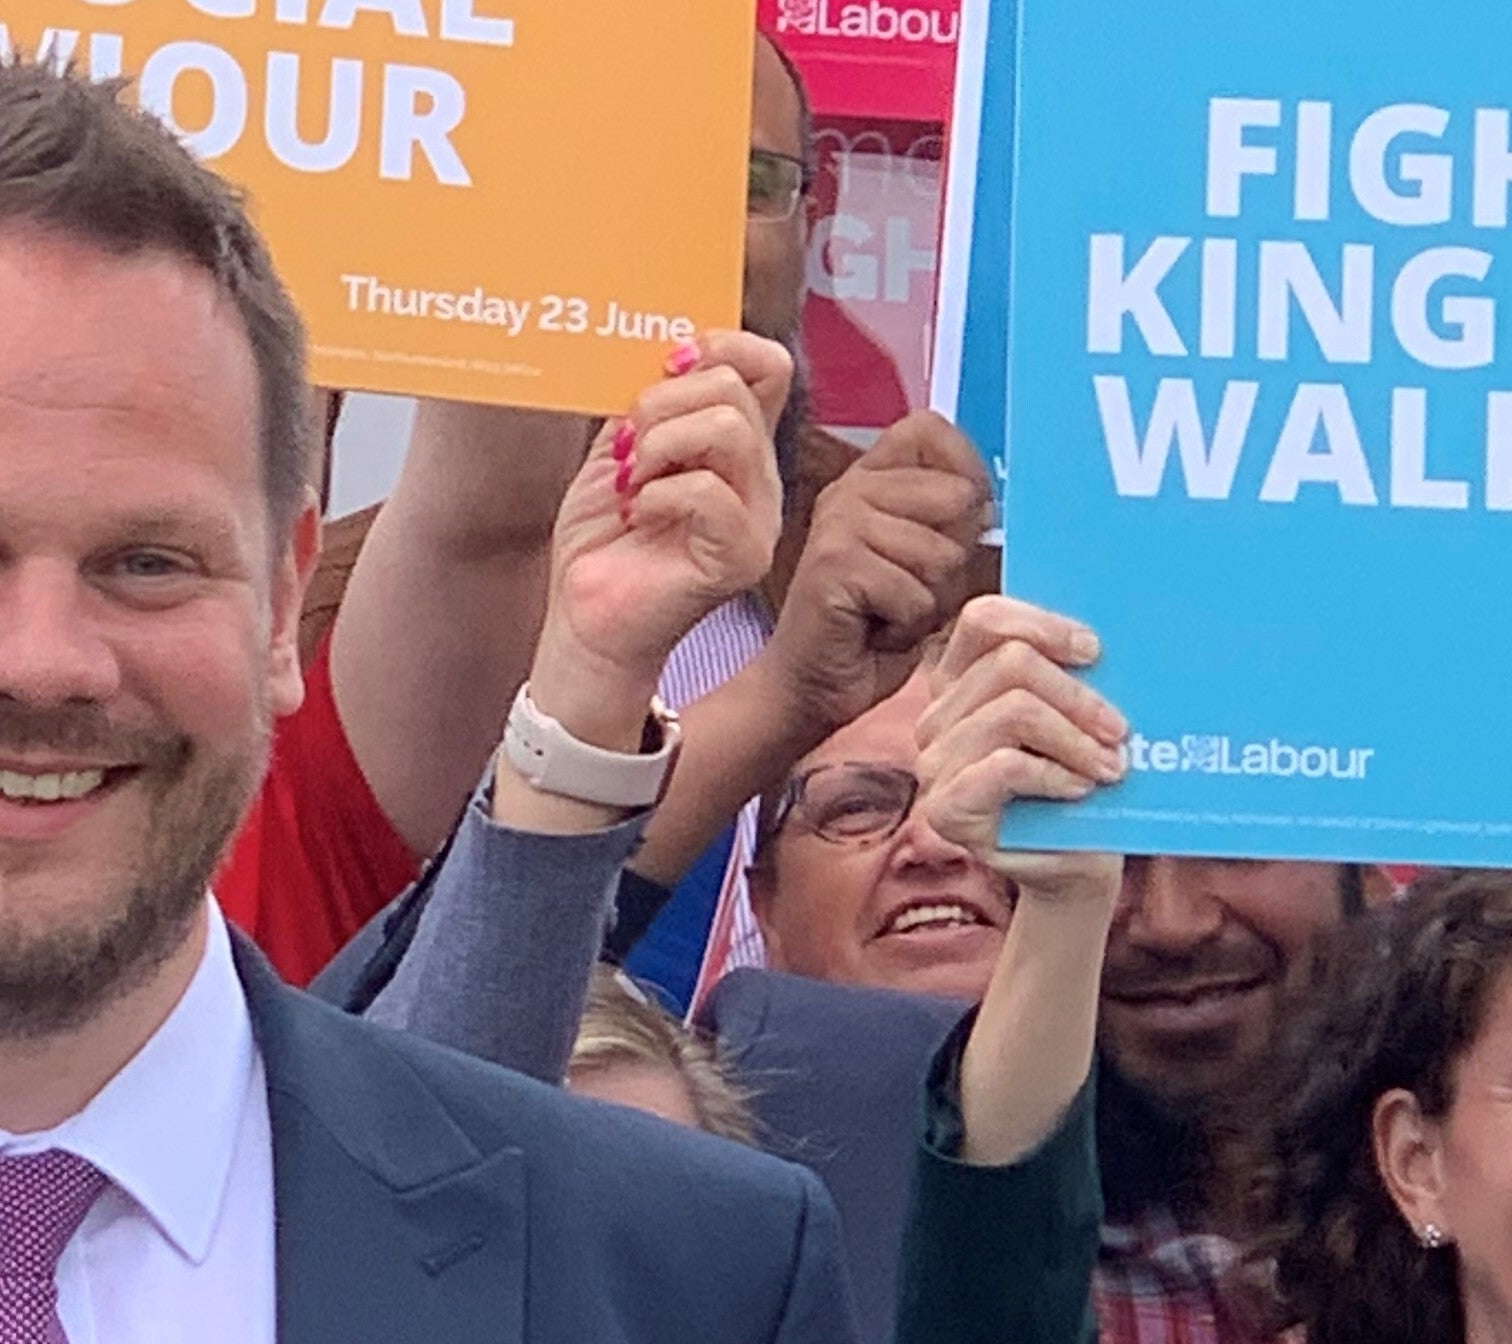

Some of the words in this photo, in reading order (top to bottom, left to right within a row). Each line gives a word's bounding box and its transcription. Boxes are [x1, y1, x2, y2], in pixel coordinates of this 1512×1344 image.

[339, 272, 533, 336] Thursday
[538, 294, 590, 334] 23
[595, 301, 696, 344] June
[1087, 232, 1497, 370] KING
[1092, 374, 1512, 512] WAL
[1220, 735, 1375, 780] Labour
